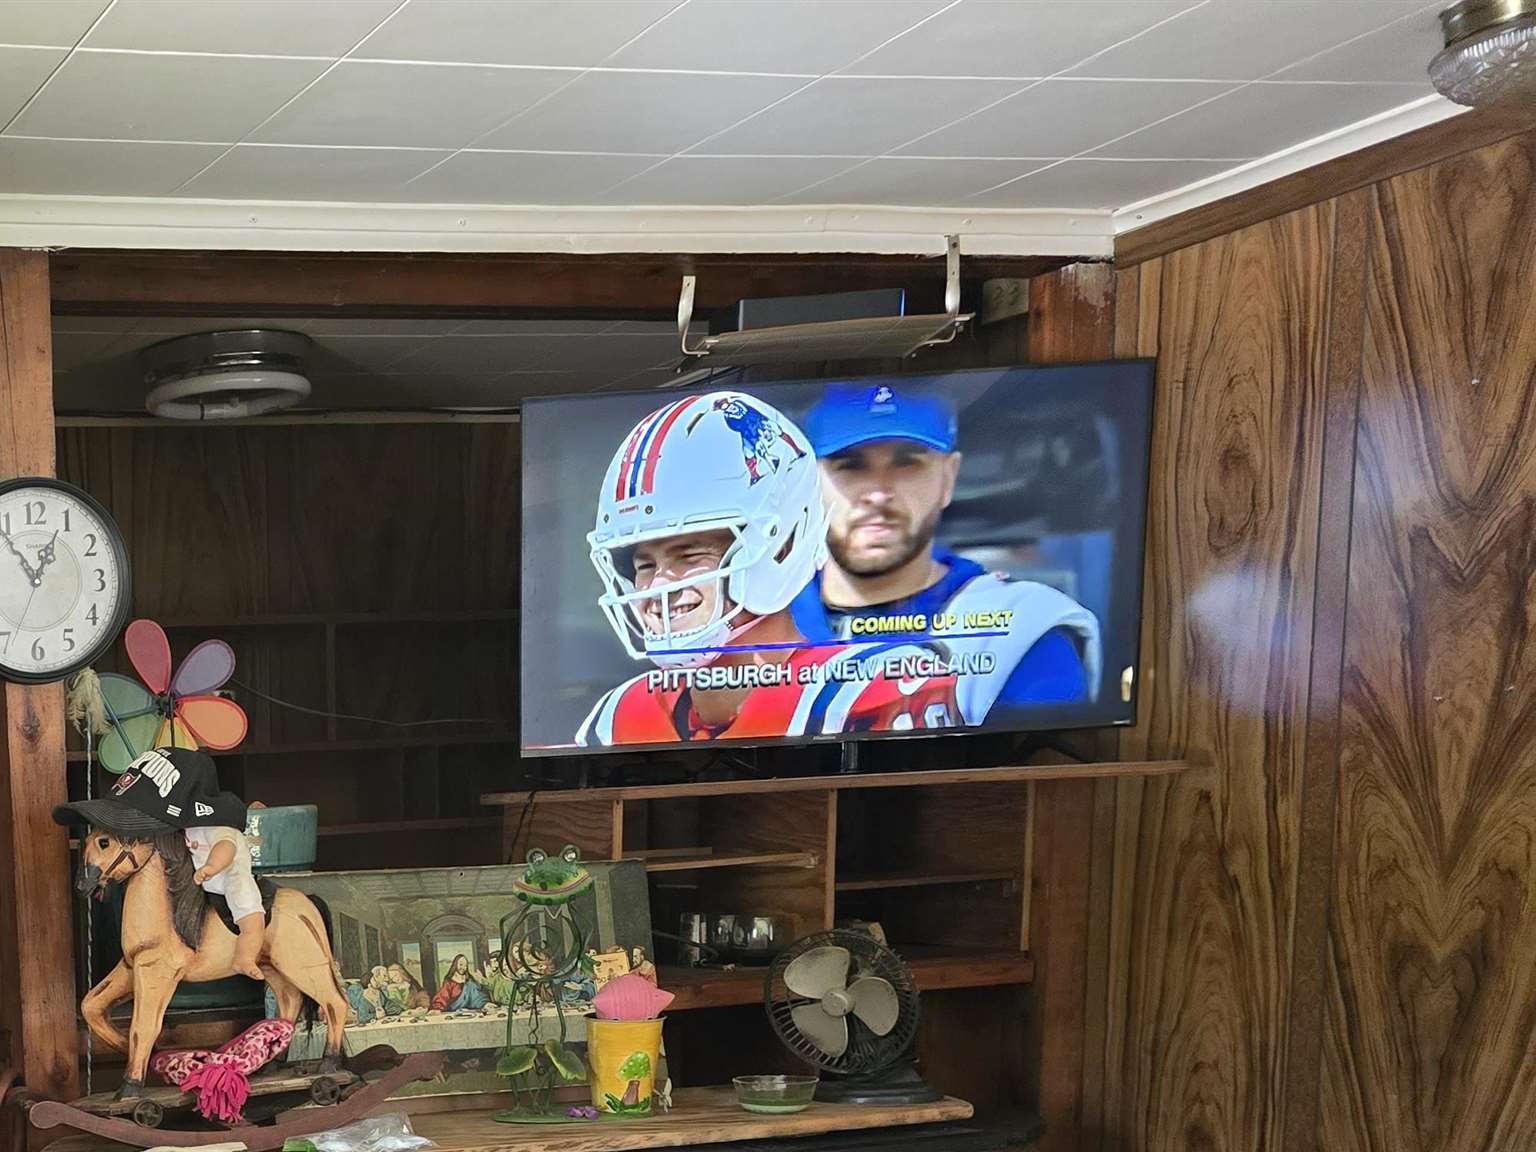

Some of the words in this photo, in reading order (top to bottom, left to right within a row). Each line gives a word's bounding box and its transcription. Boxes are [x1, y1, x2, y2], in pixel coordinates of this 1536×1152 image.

[24, 501, 47, 525] 12
[62, 508, 70, 532] 1
[83, 533, 97, 557] 2
[93, 568, 106, 592] 3
[85, 603, 99, 626] 4
[850, 613, 927, 635] COMING
[929, 613, 956, 631] UP
[963, 610, 1014, 630] NEXT
[31, 637, 45, 661] 6
[63, 628, 75, 652] 5
[648, 662, 793, 692] PITTSBURGH
[798, 662, 819, 684] at
[823, 657, 878, 683] NEW
[883, 652, 998, 679] ENGLAND
